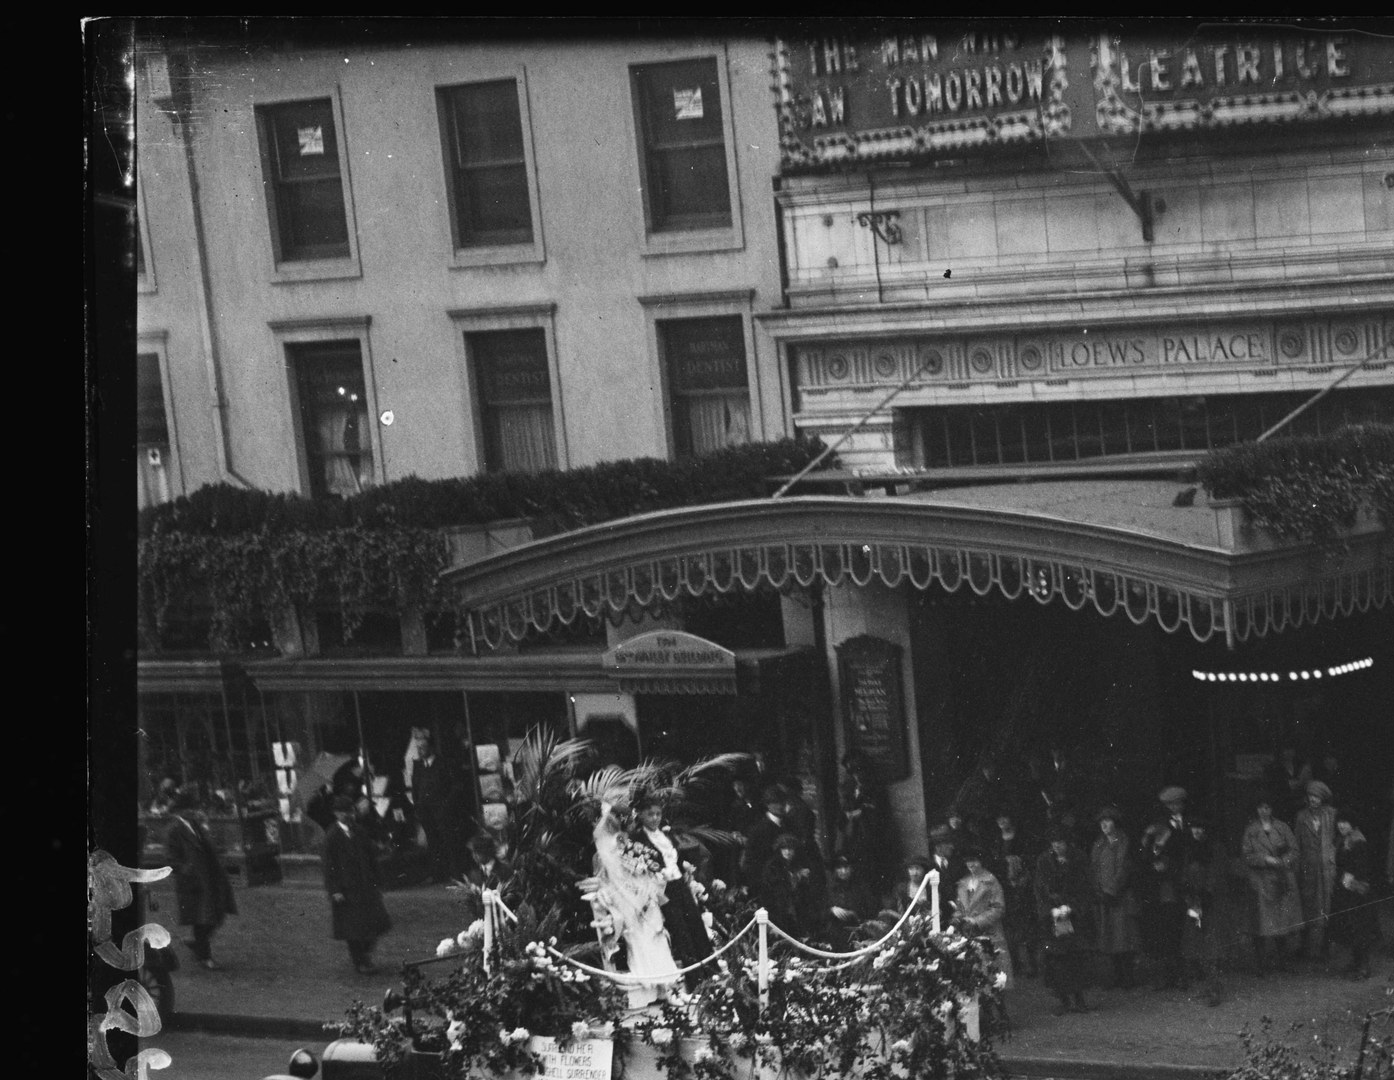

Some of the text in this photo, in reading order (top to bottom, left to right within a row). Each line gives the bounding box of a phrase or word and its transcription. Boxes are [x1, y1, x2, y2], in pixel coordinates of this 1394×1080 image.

[805, 36, 859, 76] THE
[880, 34, 939, 66] MAN
[1120, 37, 1351, 92] LEATRICE
[886, 59, 1044, 117] TOMORROW
[1163, 333, 1262, 363] PALACE
[560, 1055, 592, 1067] FLOWERS
[567, 1068, 607, 1080] SURRENDER
